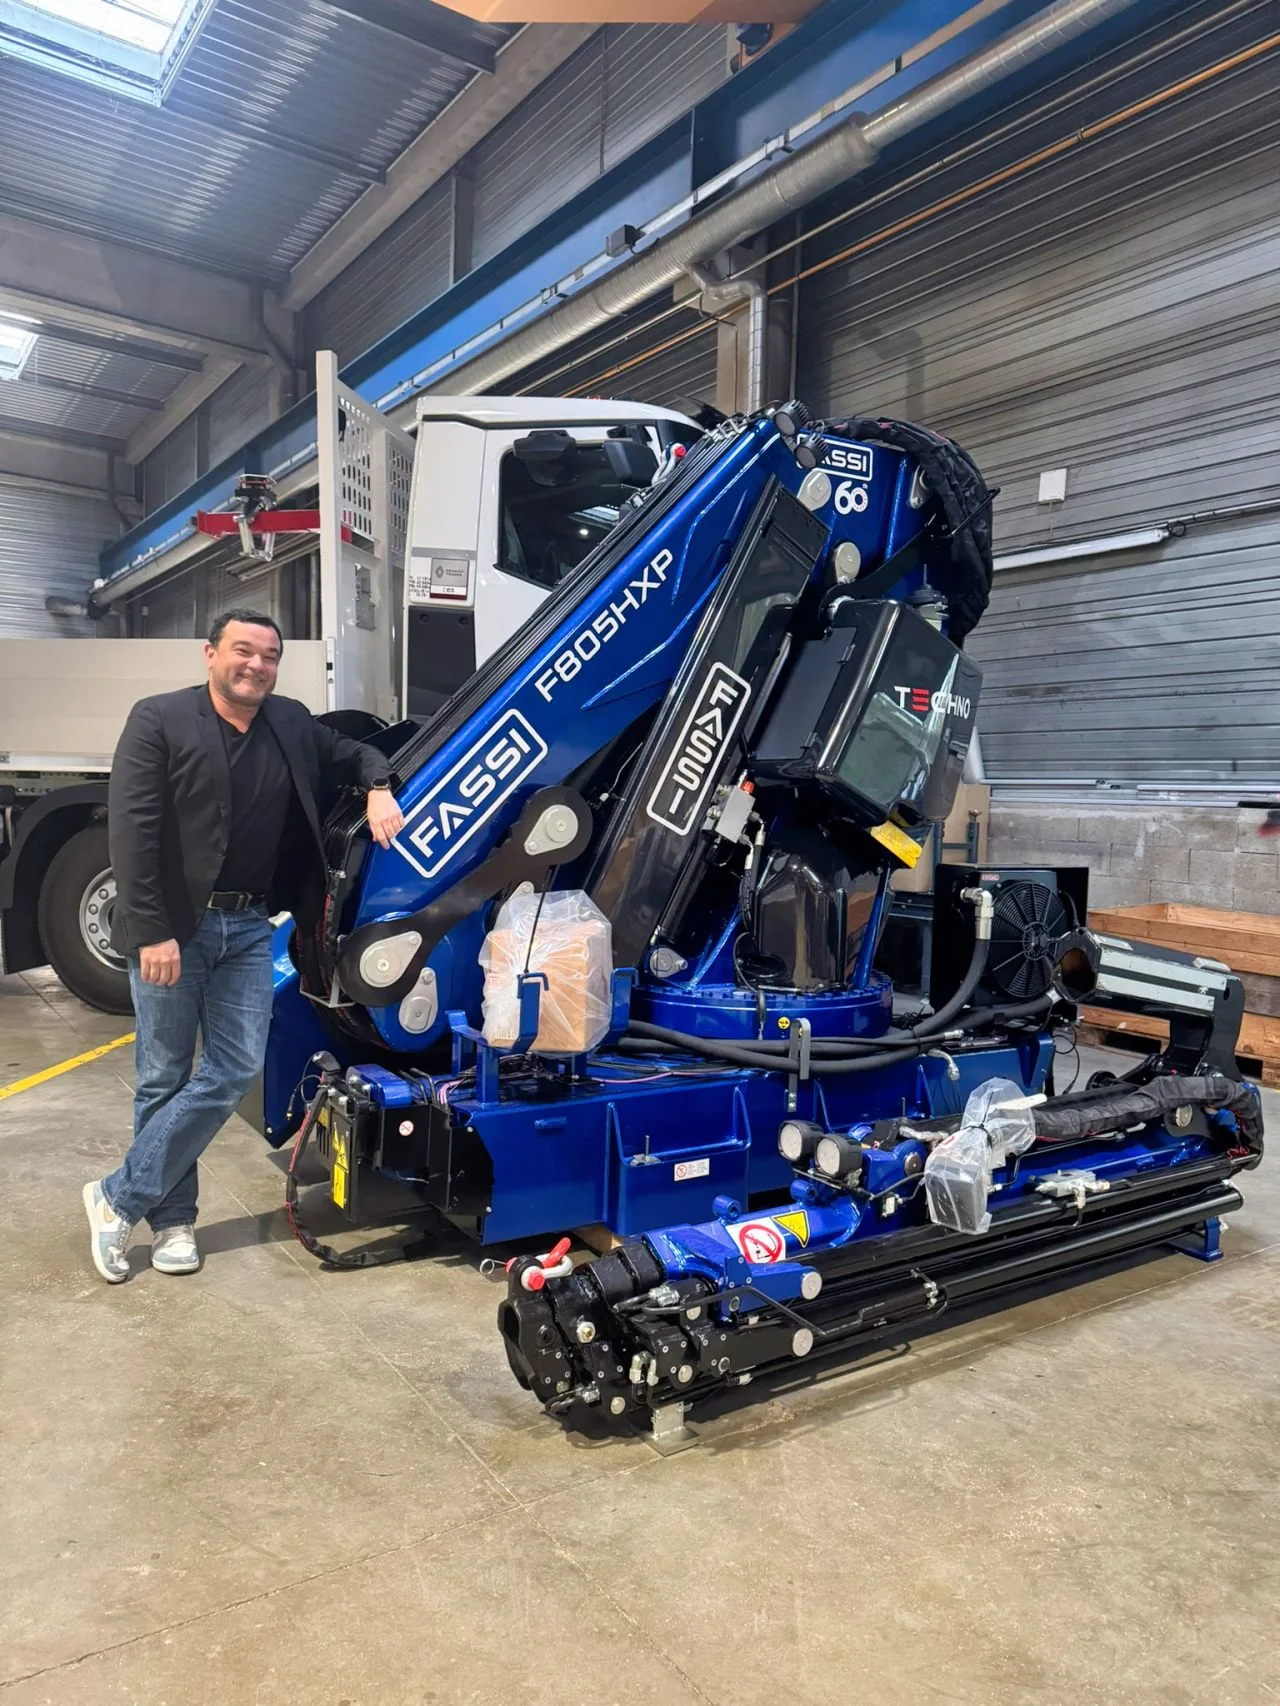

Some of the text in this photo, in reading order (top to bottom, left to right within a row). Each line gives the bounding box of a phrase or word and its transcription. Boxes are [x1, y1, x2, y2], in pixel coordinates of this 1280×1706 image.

[535, 548, 674, 702] F805HXP
[669, 679, 739, 815] FASSI
[894, 686, 970, 719] TECHNO
[409, 728, 531, 858] FASSI
